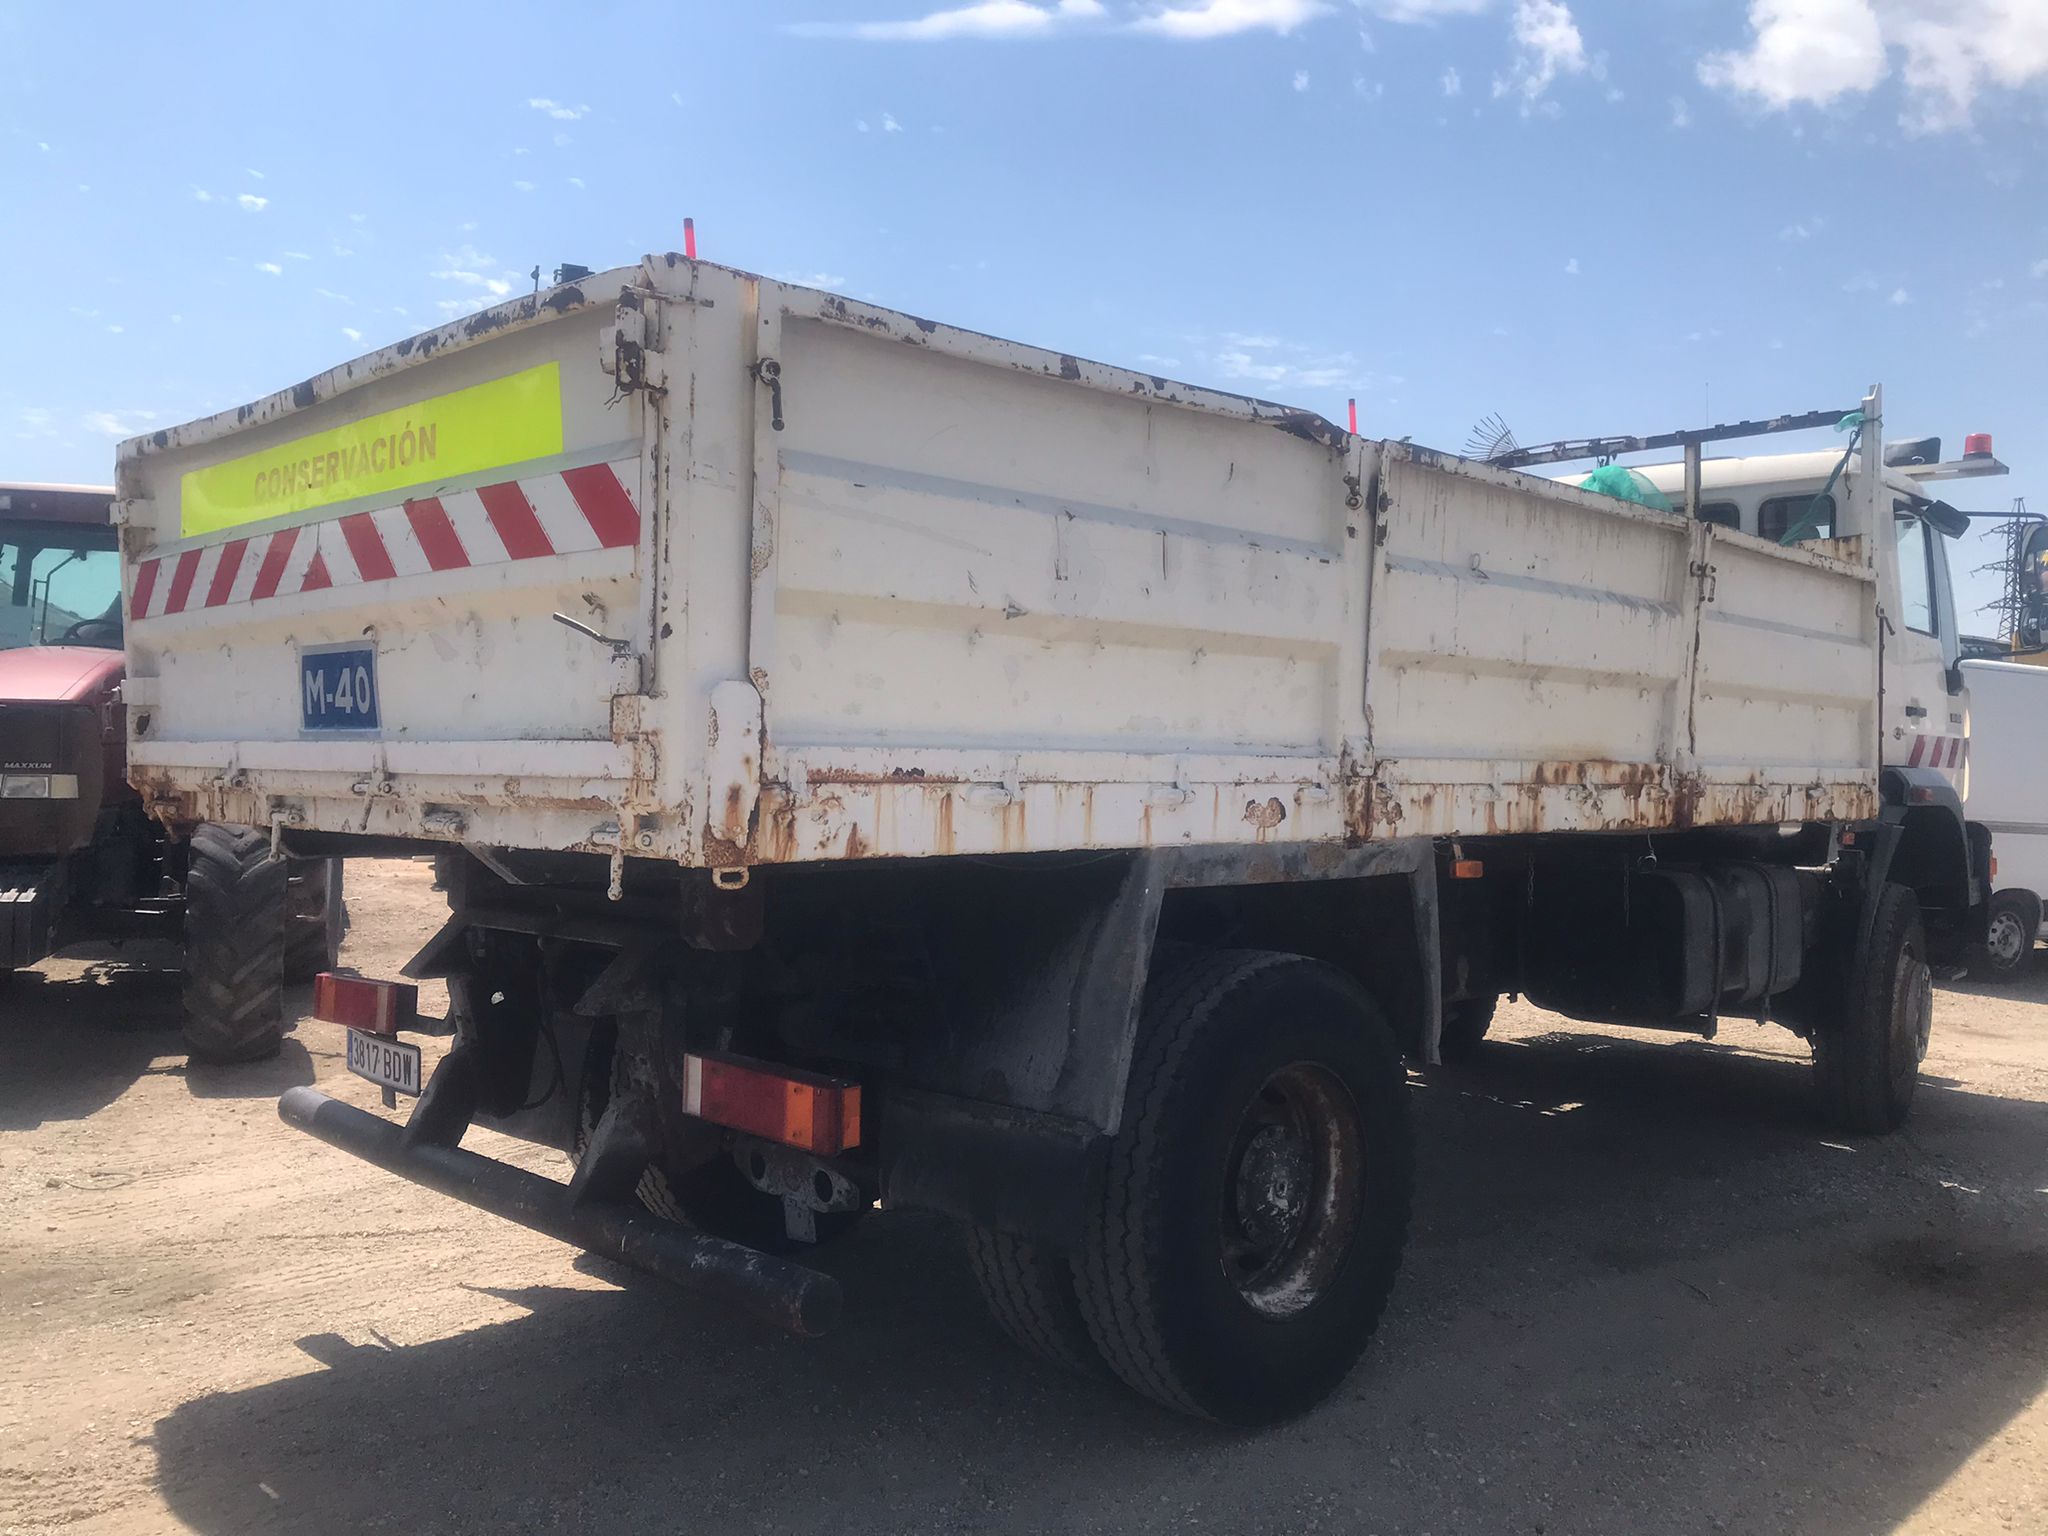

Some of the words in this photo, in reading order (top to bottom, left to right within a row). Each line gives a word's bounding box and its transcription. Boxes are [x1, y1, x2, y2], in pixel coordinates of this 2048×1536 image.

[254, 421, 437, 501] CONSERVACIÓN
[306, 666, 370, 715] M-40
[354, 1037, 379, 1074] 3817
[383, 1048, 412, 1086] BDW
